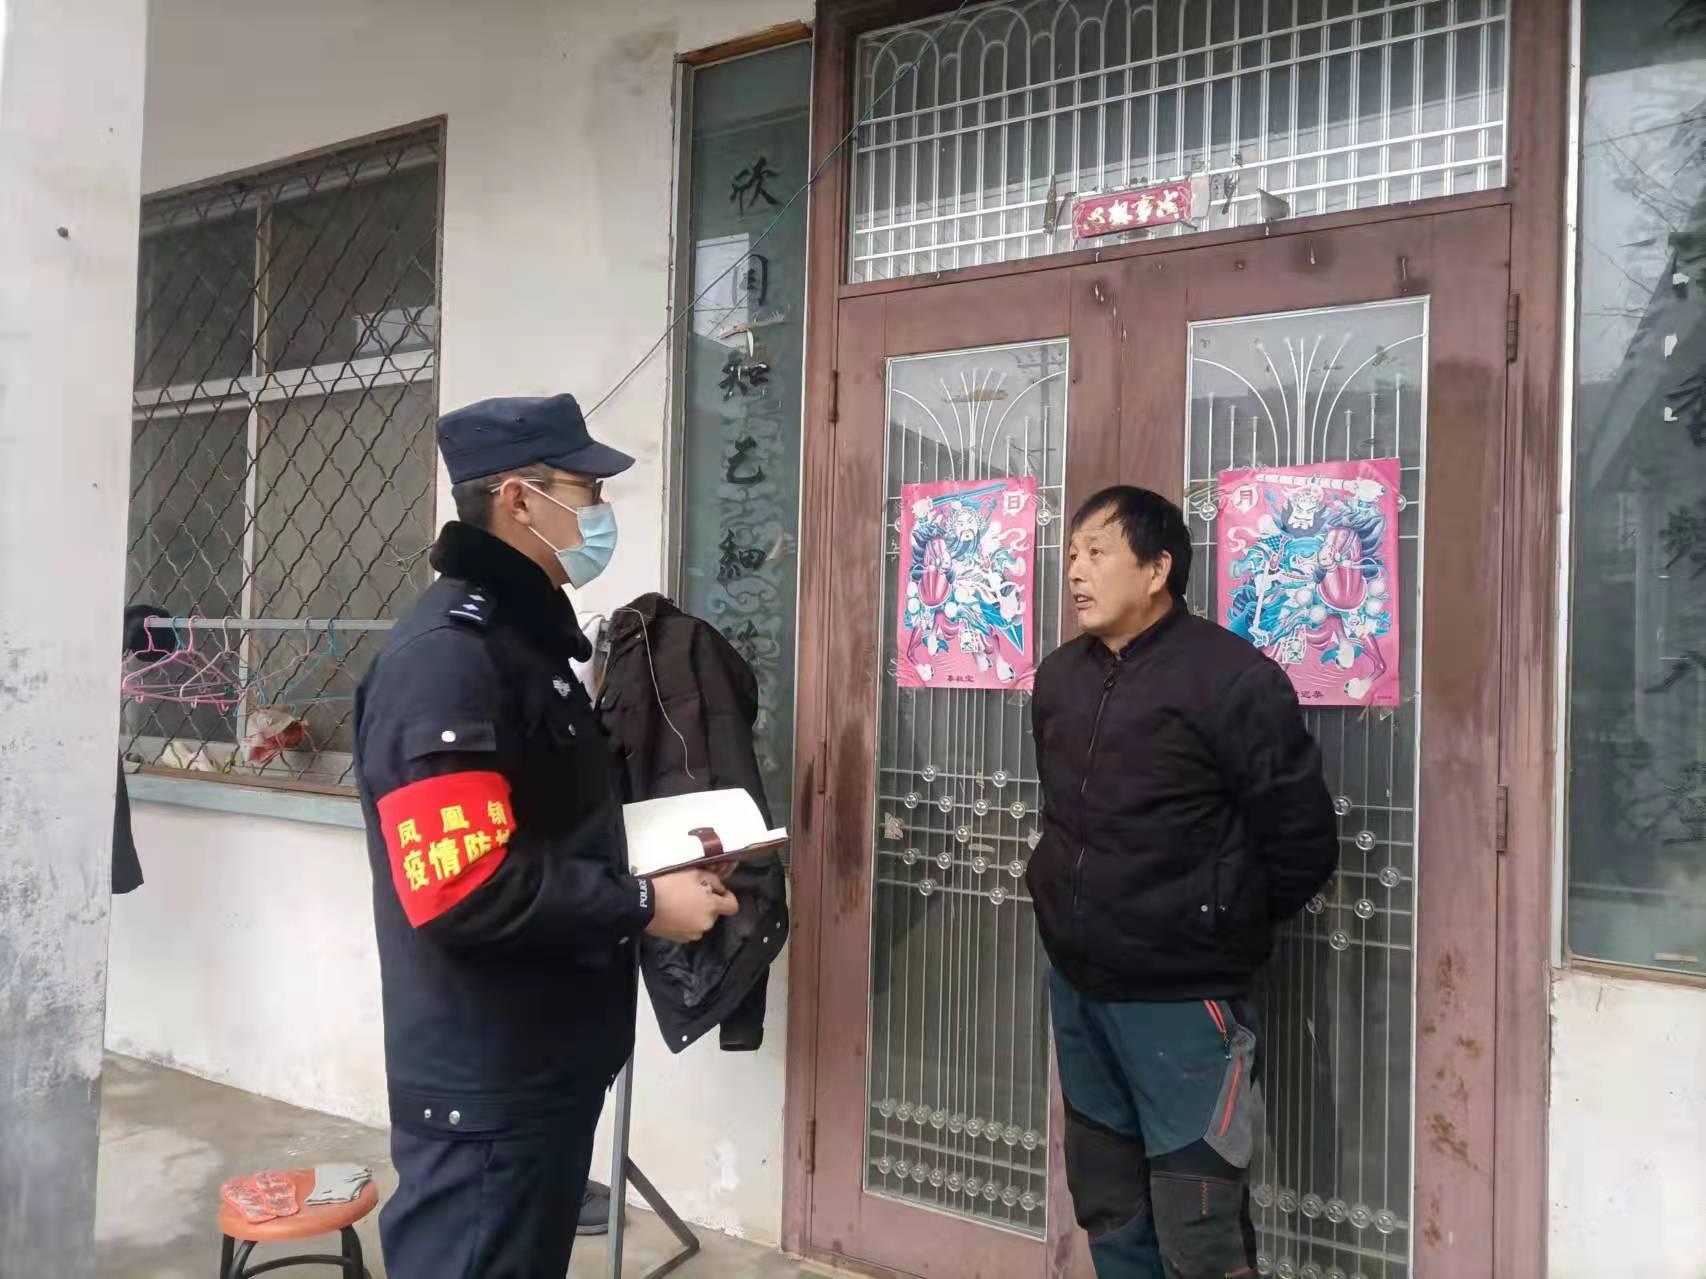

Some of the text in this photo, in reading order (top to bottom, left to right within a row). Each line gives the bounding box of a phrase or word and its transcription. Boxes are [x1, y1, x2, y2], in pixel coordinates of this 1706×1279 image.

[1006, 494, 1023, 511] 日
[1236, 488, 1255, 508] 月
[397, 800, 508, 849] 凤凰镇
